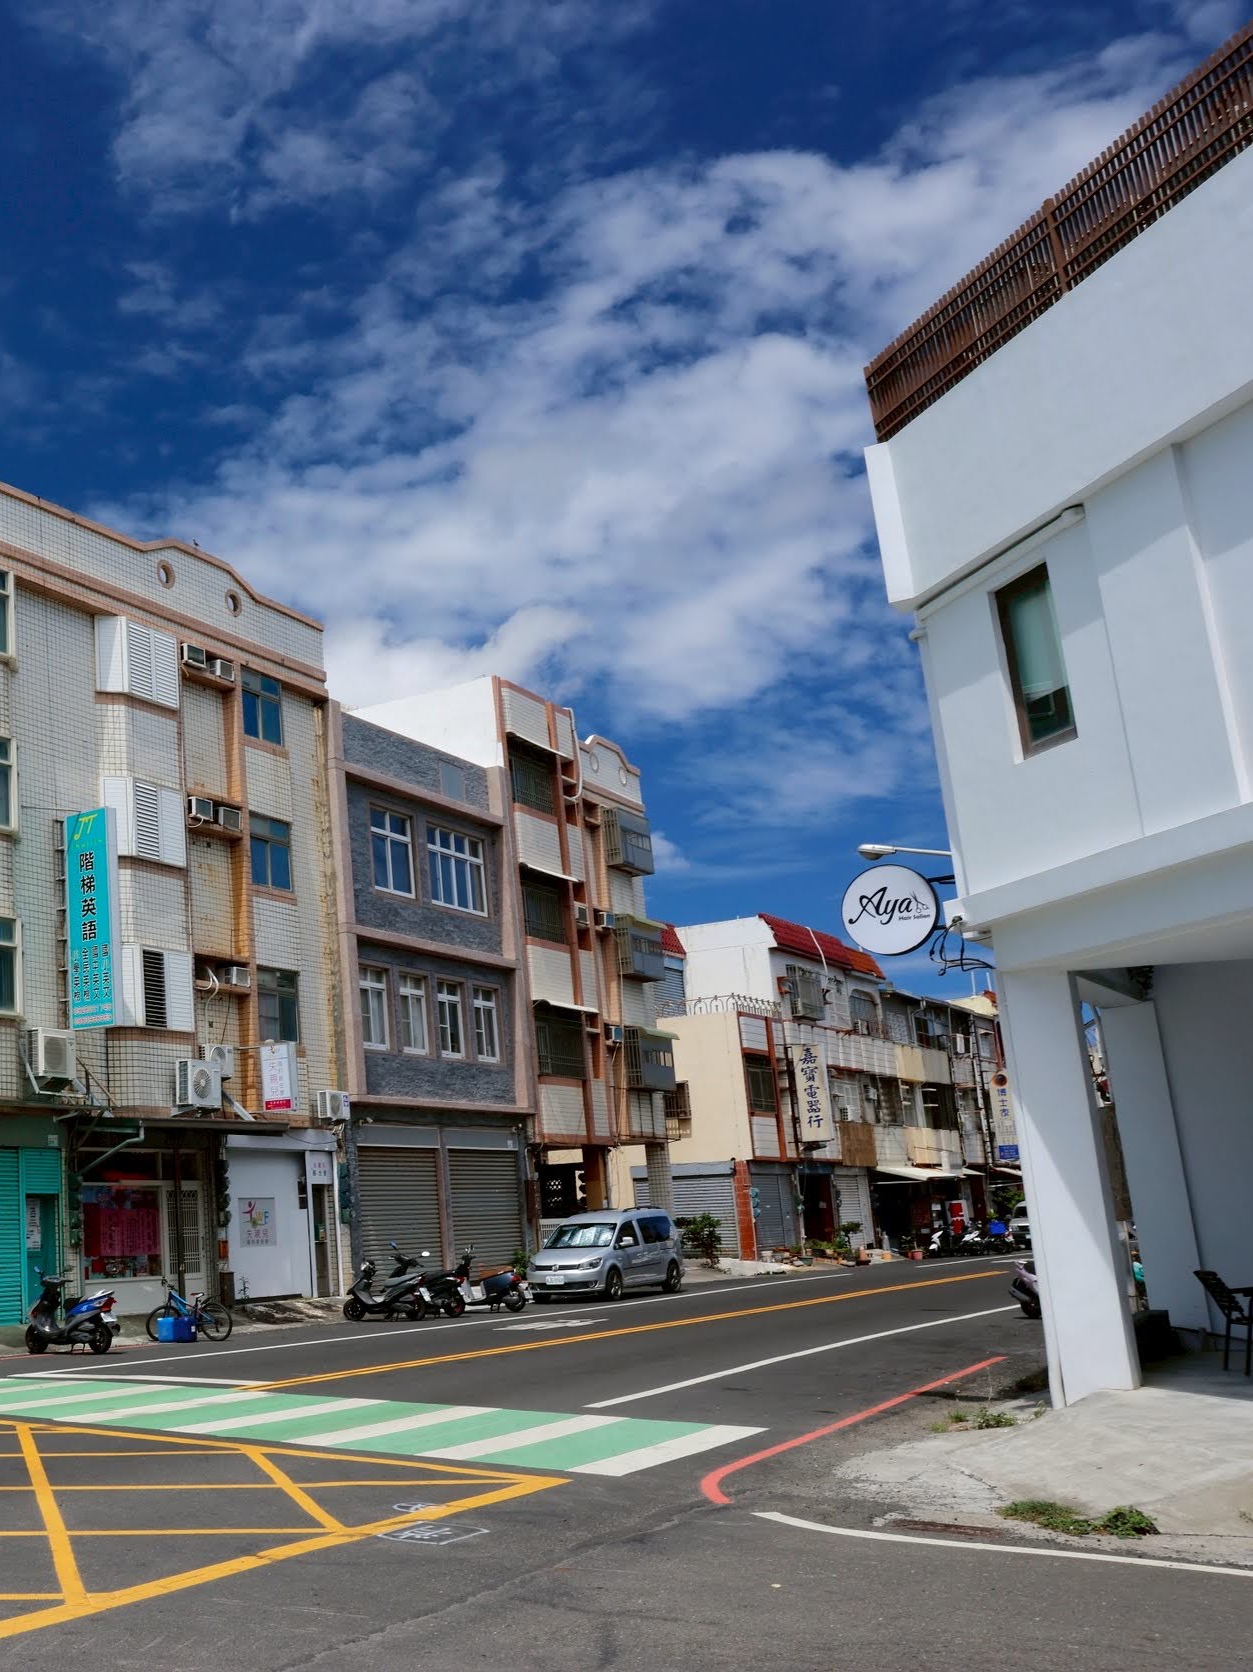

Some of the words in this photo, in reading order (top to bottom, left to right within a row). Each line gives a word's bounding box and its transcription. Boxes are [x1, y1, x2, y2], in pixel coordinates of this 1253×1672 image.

[79, 851, 97, 941] 階梯英語
[848, 886, 912, 925] Aya
[800, 1047, 824, 1129] 嘉寶電器行
